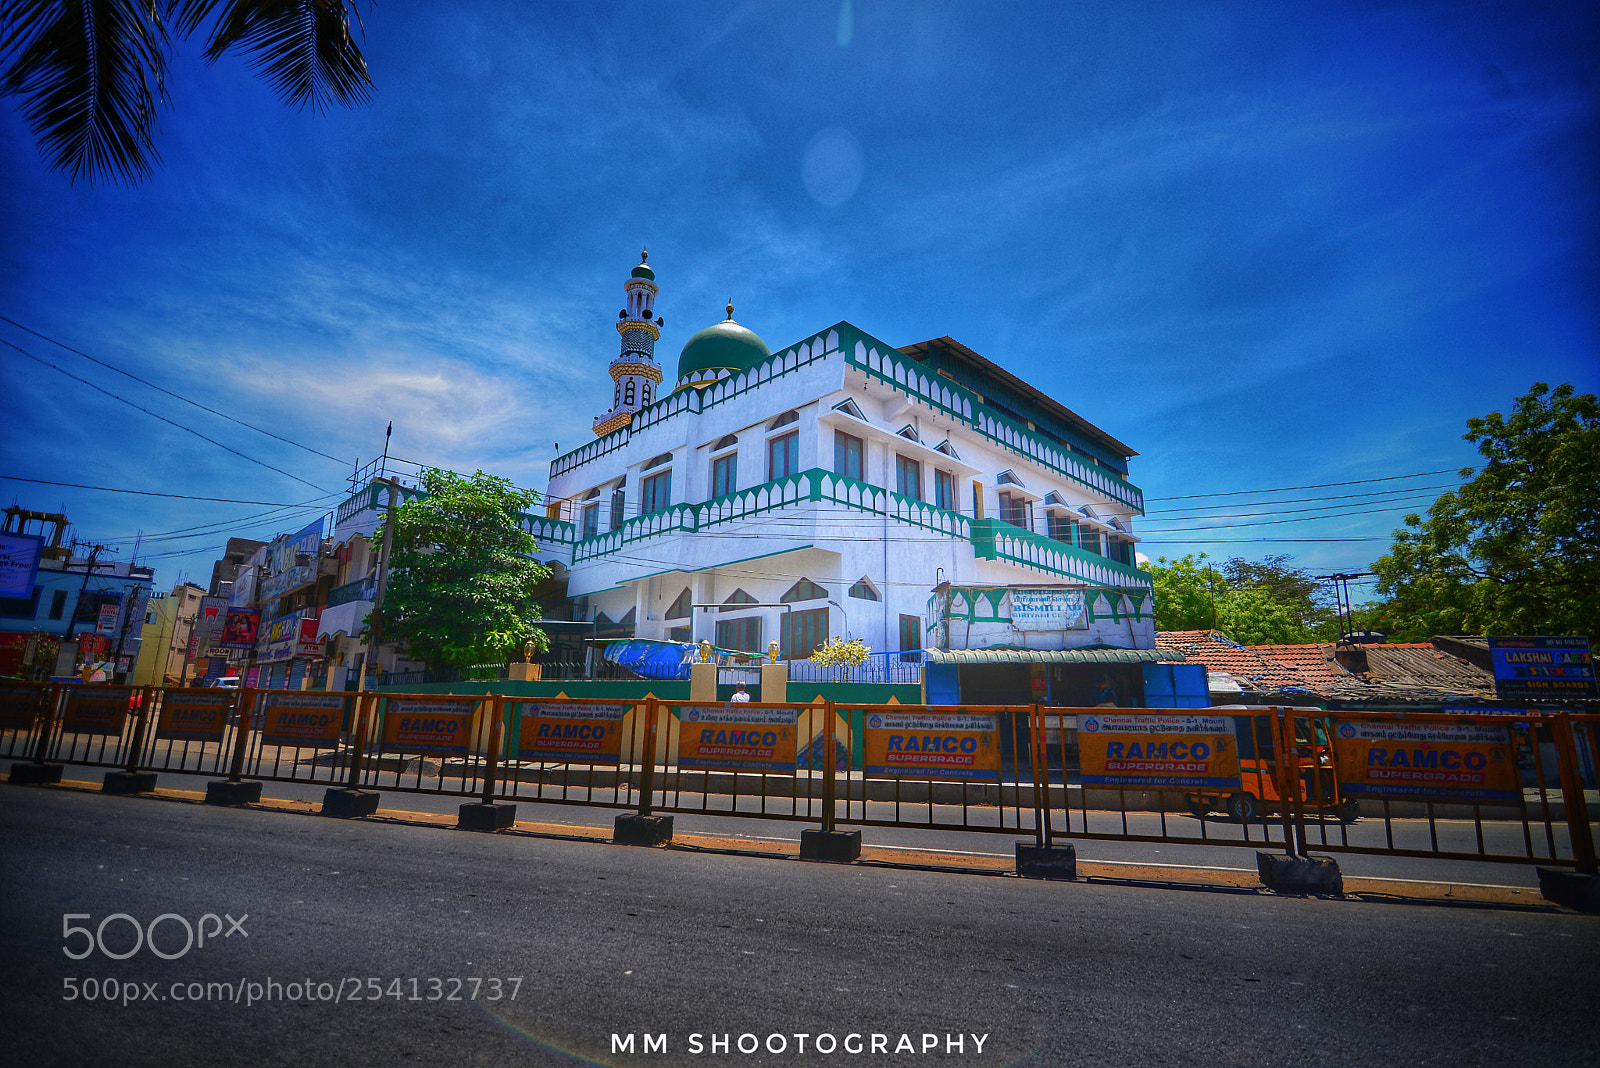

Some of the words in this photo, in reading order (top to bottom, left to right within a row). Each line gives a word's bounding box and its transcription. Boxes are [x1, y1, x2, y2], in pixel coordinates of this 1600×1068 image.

[1505, 651, 1553, 664] LAKSHMI
[172, 709, 217, 722] RAMCO
[277, 713, 329, 727] RAMCO
[400, 718, 458, 733] RAMCO
[538, 724, 605, 740] RAMCO
[699, 729, 777, 747] RAMCO
[887, 735, 977, 753] RAMCO
[538, 740, 601, 750] SUPERGRADE
[1106, 742, 1210, 760] RAMCO
[699, 747, 773, 757] SUPERGRADE
[888, 754, 973, 764] SUPERGRADE
[1367, 748, 1486, 771] RAMCO
[1108, 763, 1206, 772] SUPERGRADE
[1104, 776, 1152, 785] Engineered
[1169, 777, 1208, 785] Concrete
[1369, 770, 1482, 783] SUPERGRADE
